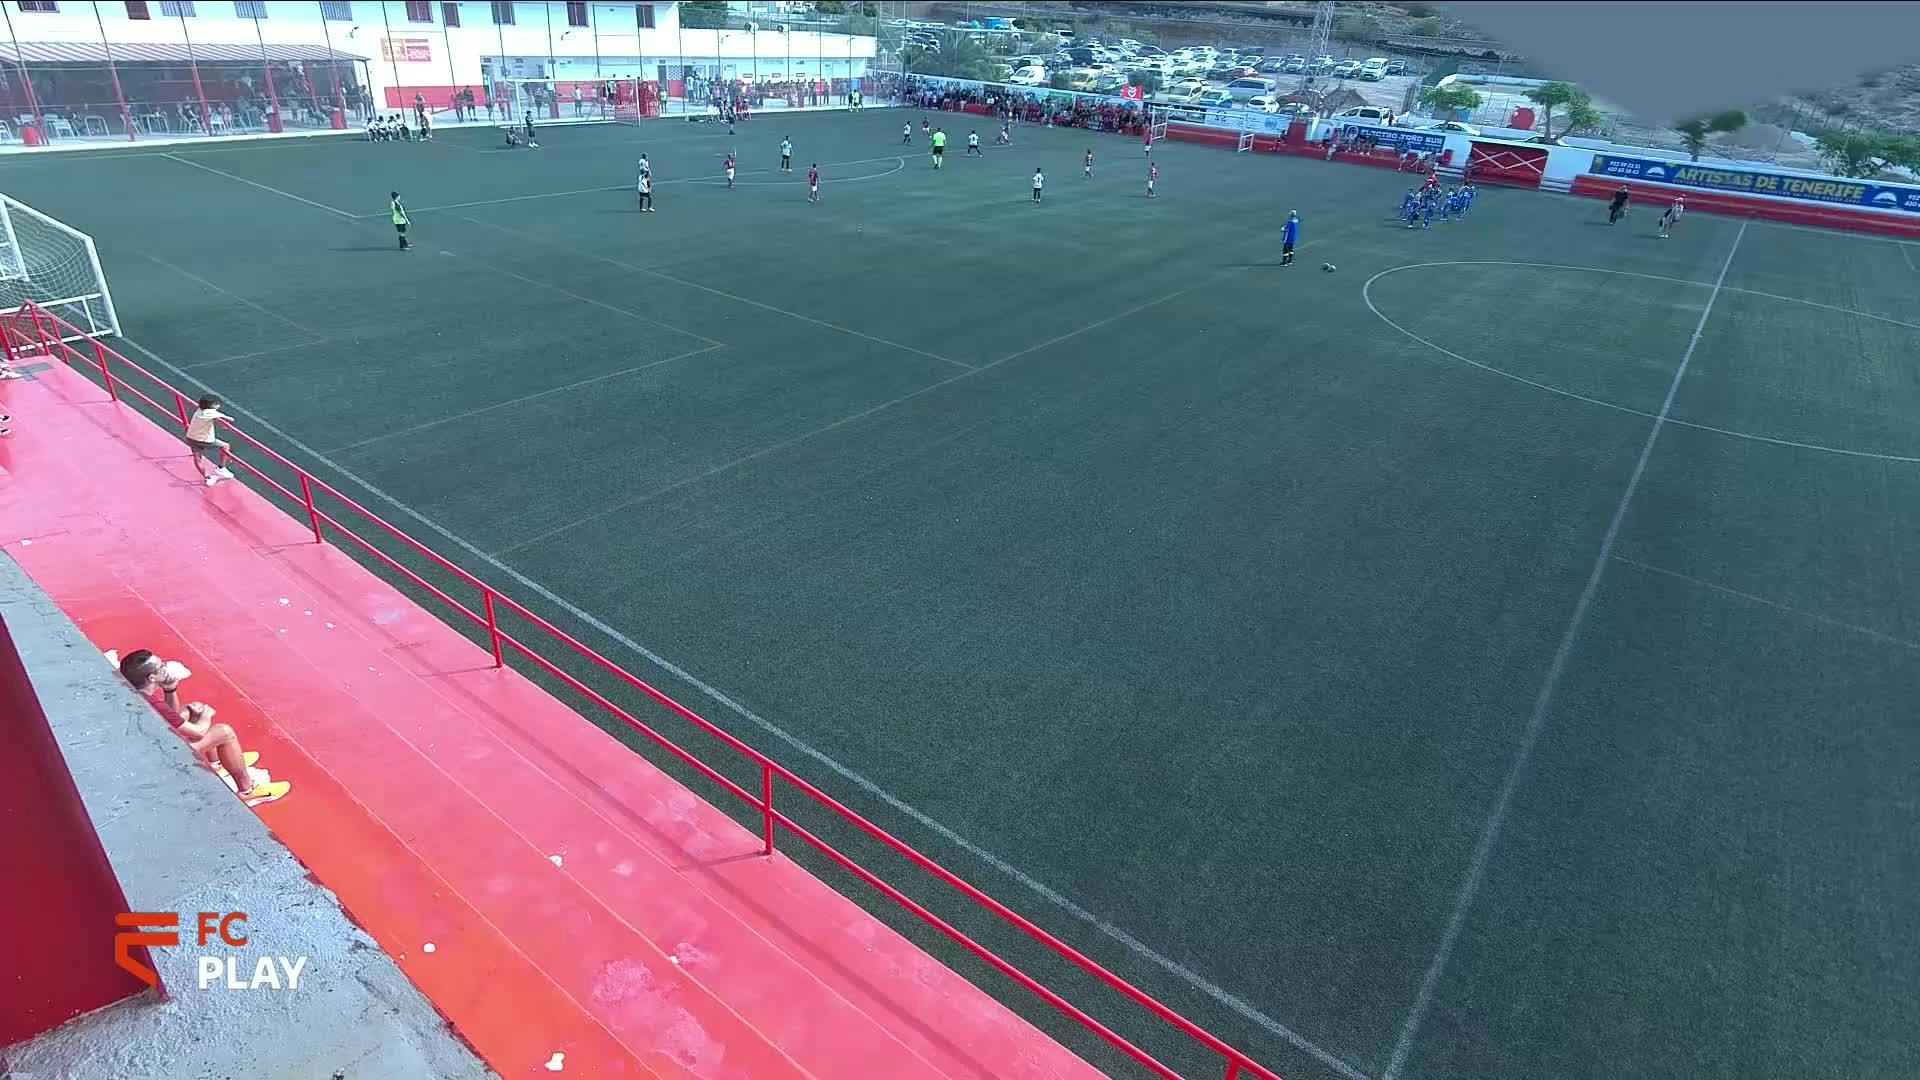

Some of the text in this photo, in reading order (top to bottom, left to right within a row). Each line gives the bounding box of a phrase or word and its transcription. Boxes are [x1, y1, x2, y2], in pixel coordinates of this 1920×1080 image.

[1674, 167, 1753, 187] ARTISTAS
[1755, 174, 1779, 190] DE
[1782, 177, 1866, 199] TENERIFE
